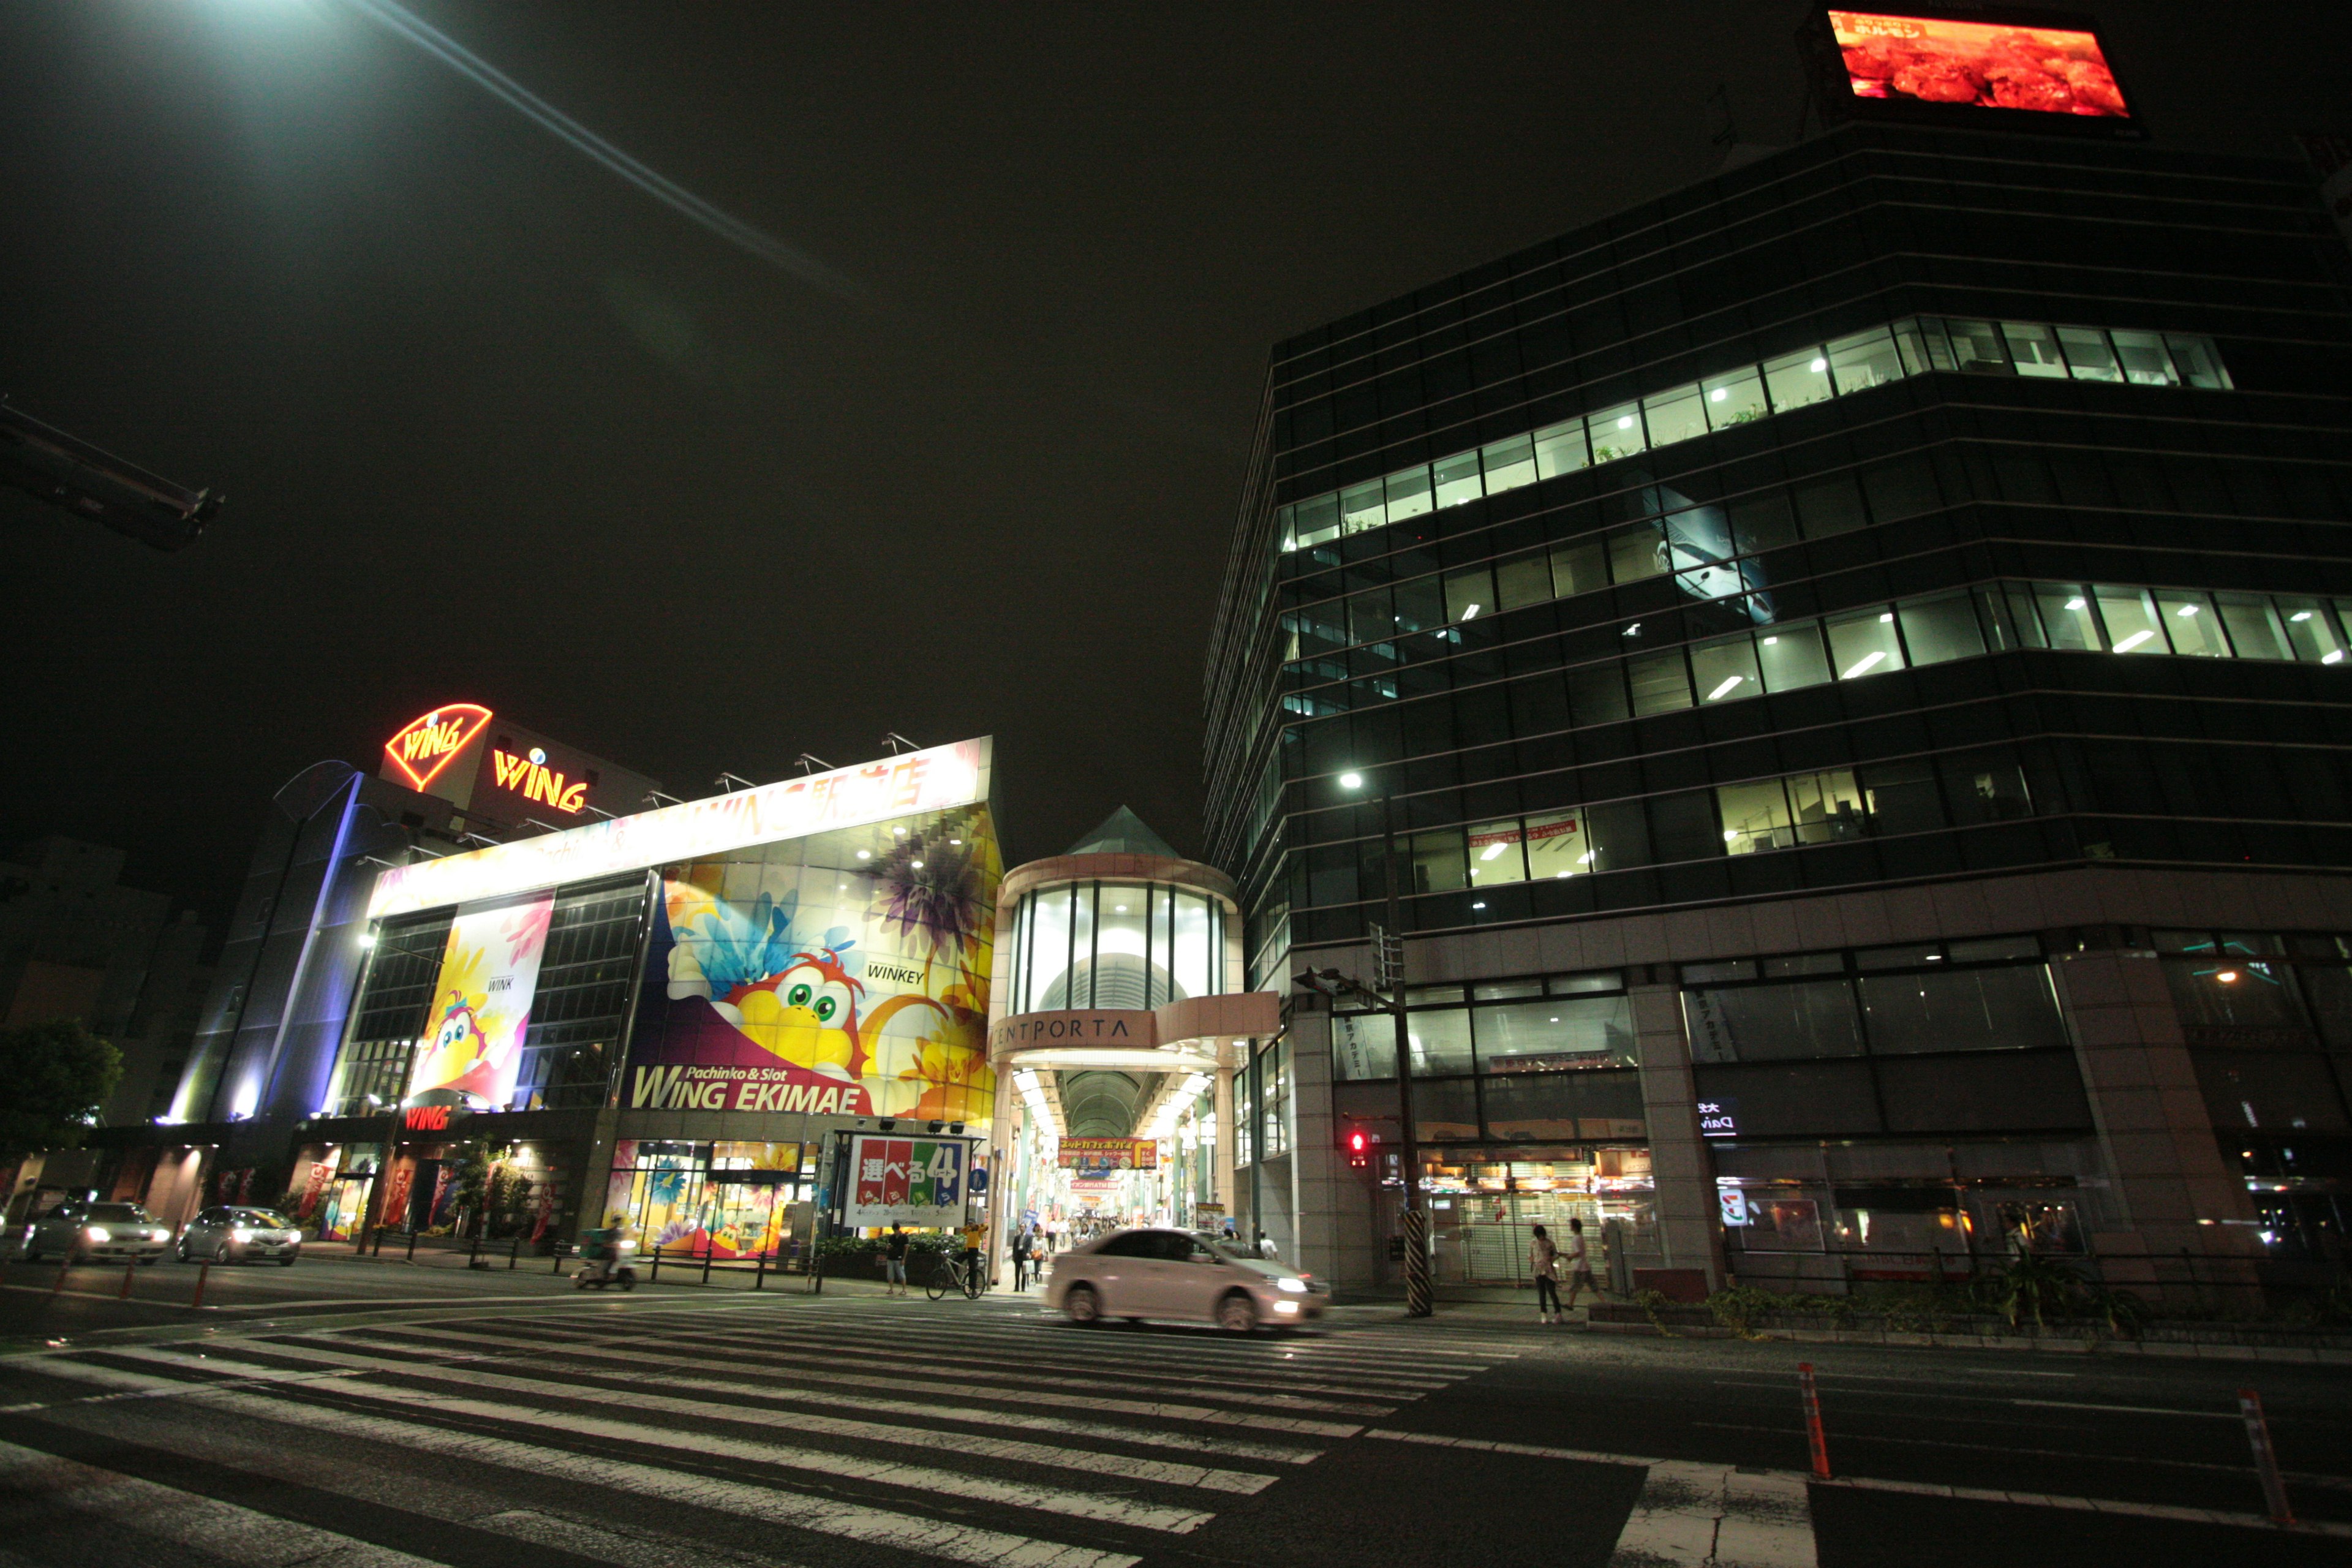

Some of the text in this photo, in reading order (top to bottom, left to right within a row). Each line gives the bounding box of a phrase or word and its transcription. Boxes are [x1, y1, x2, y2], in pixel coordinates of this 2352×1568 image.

[494, 747, 587, 813] WING
[488, 978, 514, 992] WINK
[868, 964, 925, 985] WINKEY
[686, 1066, 788, 1082] Pachinko & Slot
[631, 1065, 861, 1115] WING EKIMAE
[406, 1105, 451, 1131] WING
